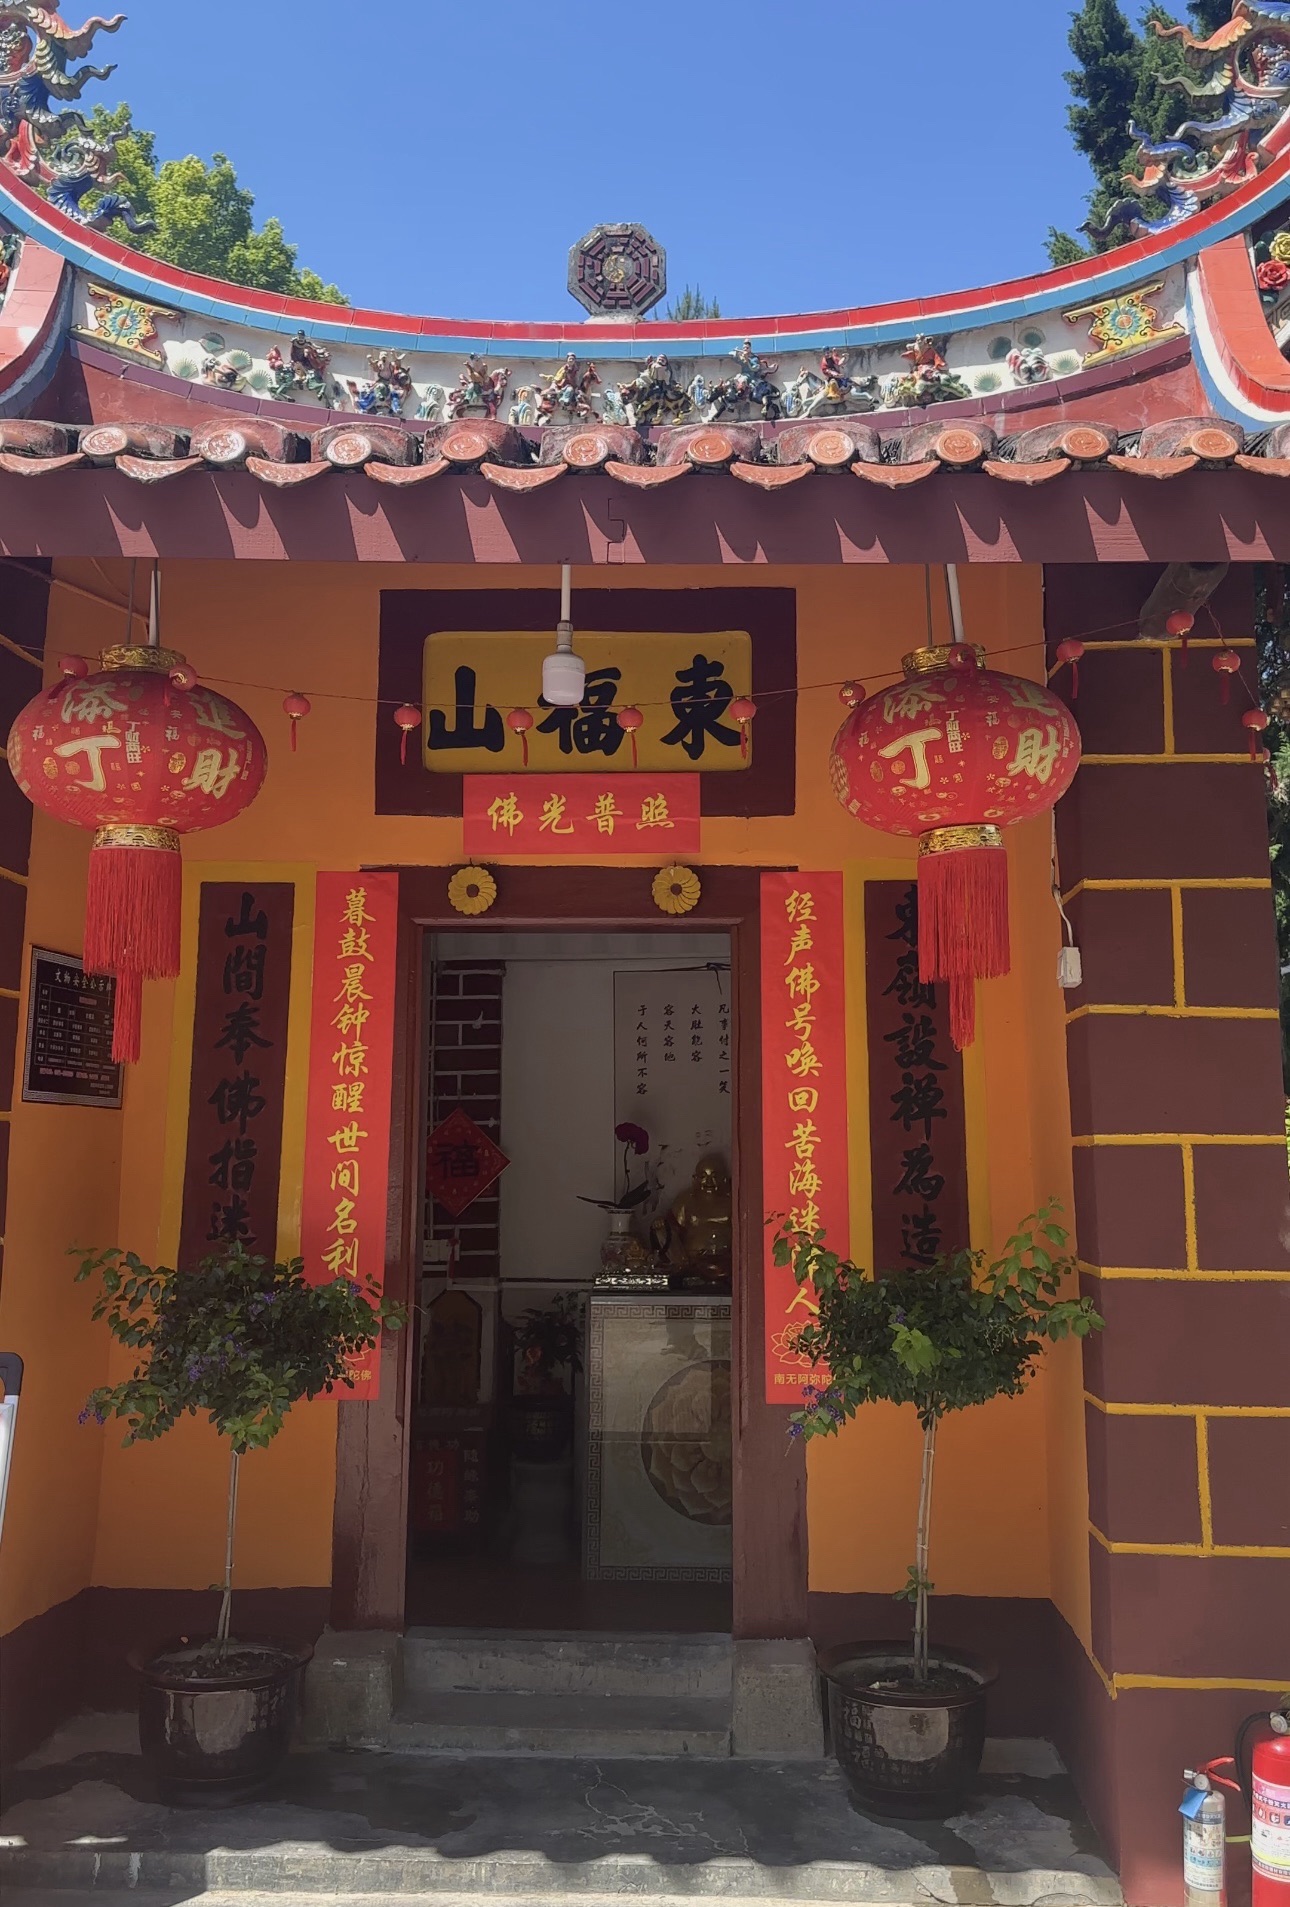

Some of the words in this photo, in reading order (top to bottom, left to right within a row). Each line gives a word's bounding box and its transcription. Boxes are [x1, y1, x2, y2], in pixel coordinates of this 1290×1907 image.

[487, 792, 676, 837] 佛光普照
[663, 1004, 676, 1062] 容天容地
[690, 1003, 703, 1063] 大肚能容
[321, 887, 376, 1298] 暮鼓晨钟惊醒世间名利
[774, 1373, 836, 1385] 南无阿弥陀
